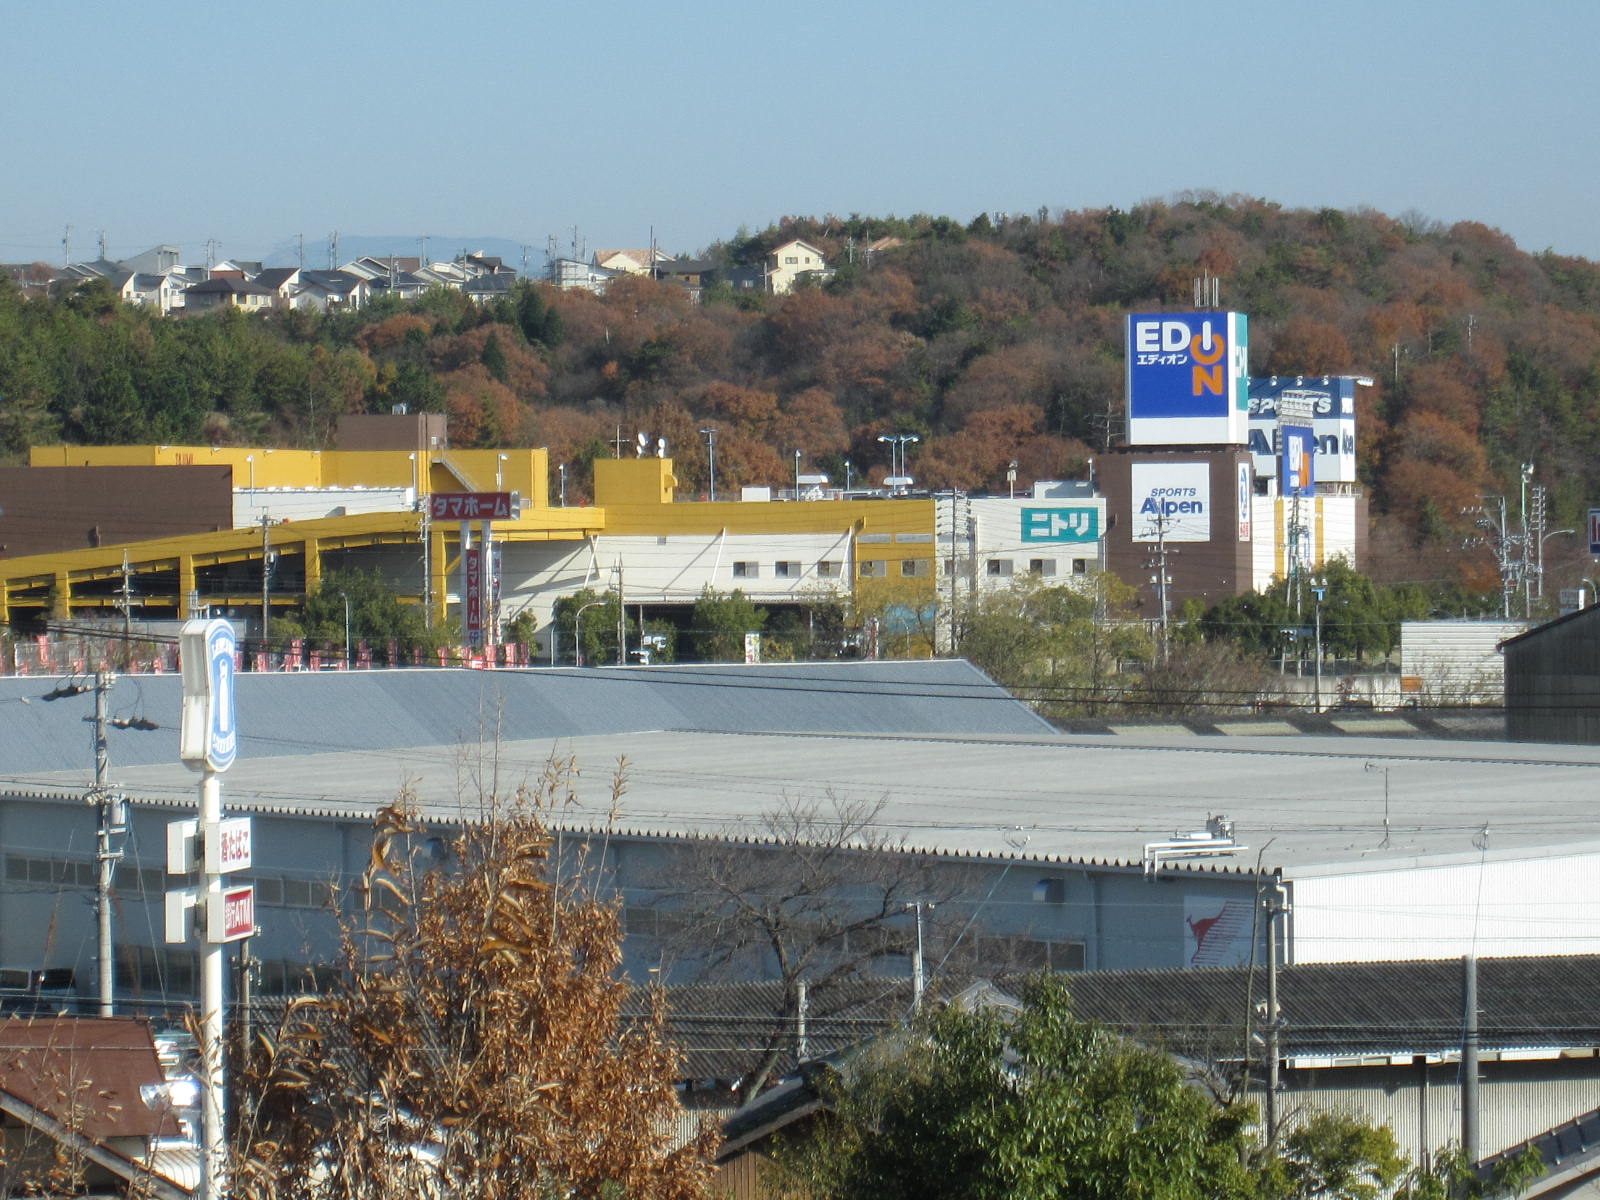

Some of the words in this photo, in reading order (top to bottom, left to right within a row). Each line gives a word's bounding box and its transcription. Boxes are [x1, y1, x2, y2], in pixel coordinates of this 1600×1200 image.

[1136, 320, 1225, 396] EDION
[1136, 353, 1188, 366] エディオン
[1150, 487, 1197, 497] SPORTS
[432, 496, 509, 517] タマホーム
[1140, 497, 1203, 518] Alpen
[1030, 512, 1089, 537] ニトリ
[468, 556, 479, 625] タマホーム
[221, 830, 250, 863] 酒たばこ
